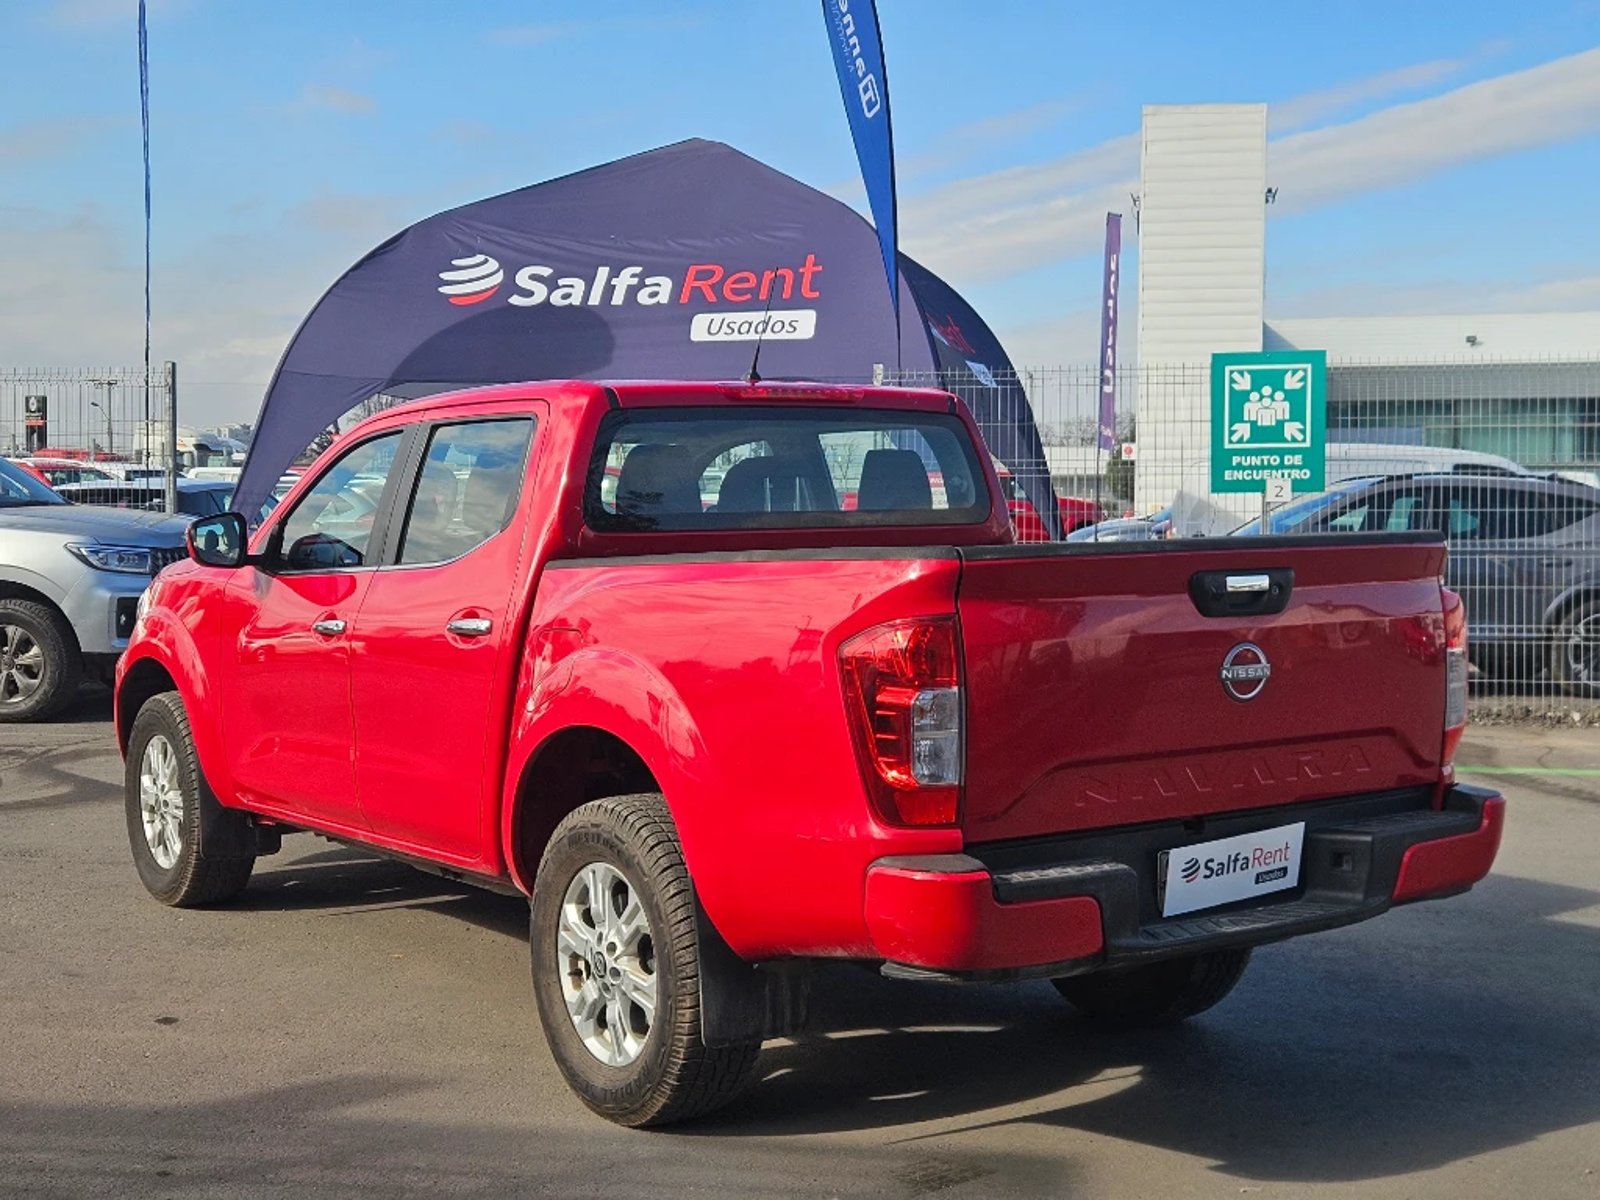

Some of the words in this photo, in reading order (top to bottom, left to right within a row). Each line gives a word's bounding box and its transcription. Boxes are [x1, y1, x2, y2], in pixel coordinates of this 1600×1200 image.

[706, 315, 799, 337] Usados
[1232, 455, 1280, 467] PUNTO
[1284, 454, 1303, 466] DE
[1224, 469, 1311, 481] ENCUENTRO
[1274, 485, 1284, 498] 2
[1221, 665, 1270, 679] NISSAN
[1075, 744, 1371, 807] NAVARA
